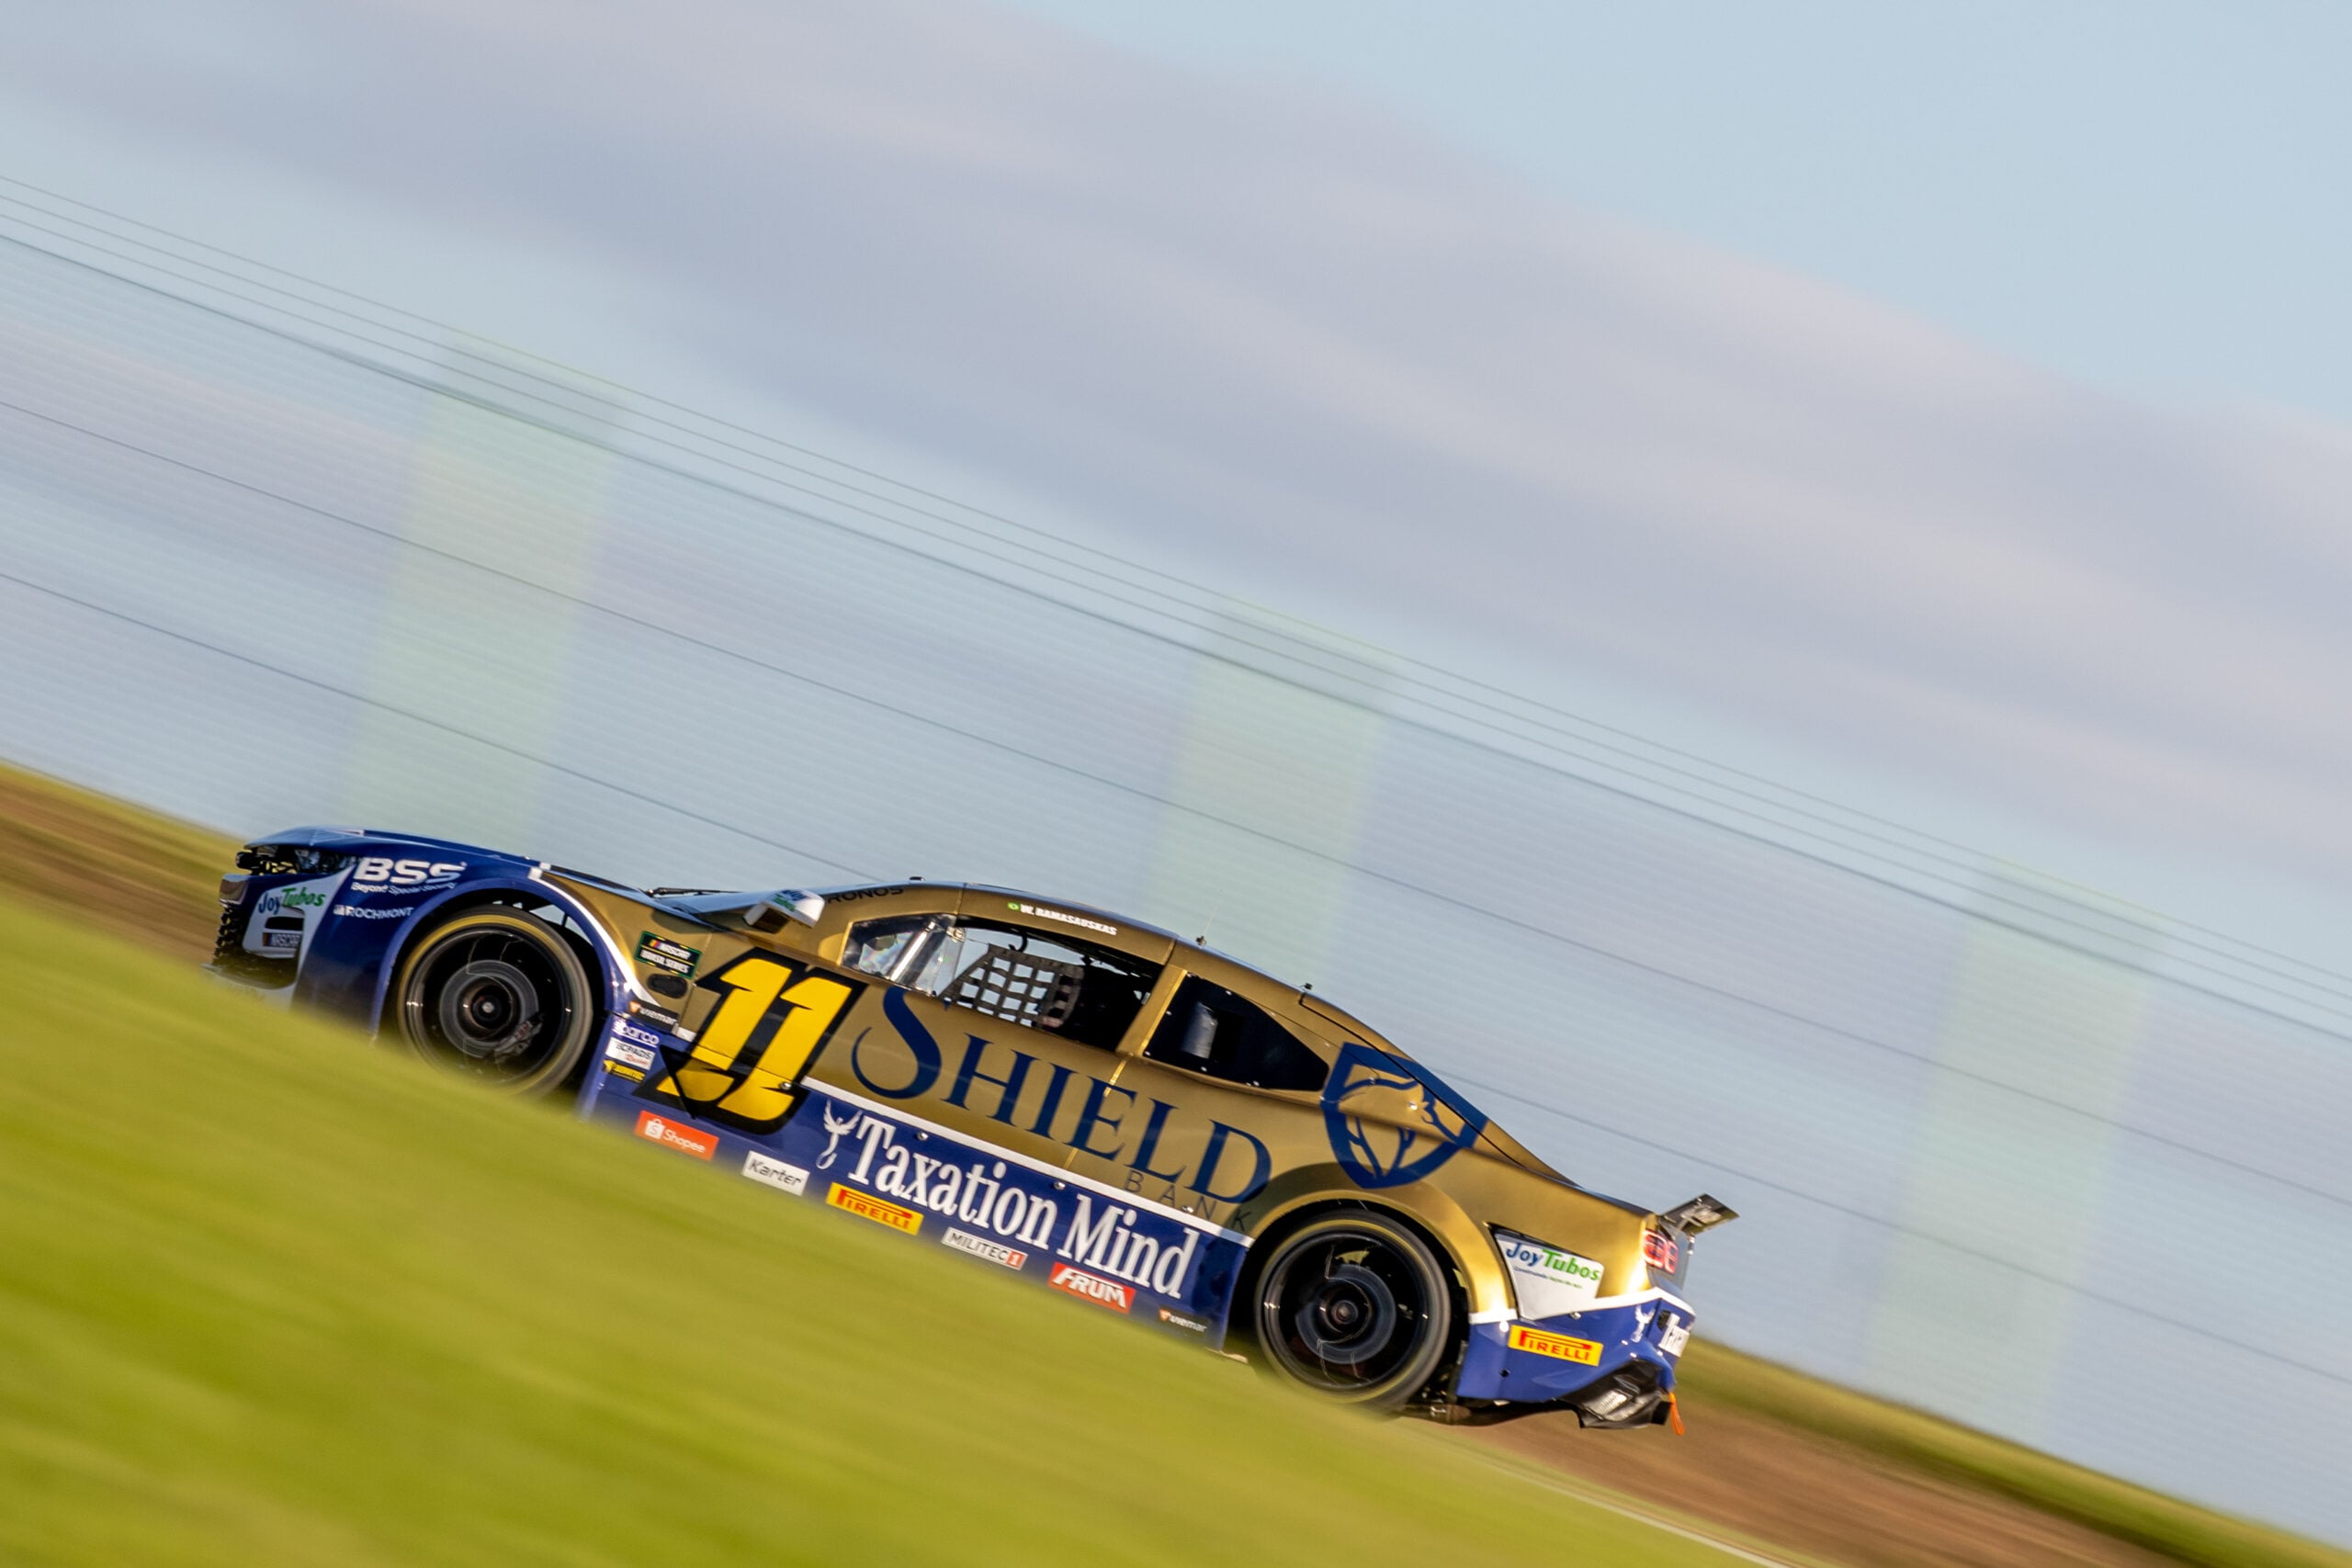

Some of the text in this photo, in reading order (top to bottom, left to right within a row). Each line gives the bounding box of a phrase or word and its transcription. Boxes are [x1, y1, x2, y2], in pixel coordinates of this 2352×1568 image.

[353, 857, 467, 885] BSS
[827, 887, 903, 903] RONOS
[655, 957, 852, 1121] 11
[851, 985, 1272, 1204] SHIELD
[662, 1129, 706, 1154] Shopee
[748, 1159, 802, 1187] Karter
[840, 1189, 913, 1229] PIRELLI
[847, 1115, 1200, 1299] Taxation Mind
[1126, 1169, 1255, 1232] BANK
[1506, 1242, 1600, 1281] JoyTubos
[1054, 1268, 1126, 1309] FRUM
[1519, 1330, 1593, 1361] PIRELLI
